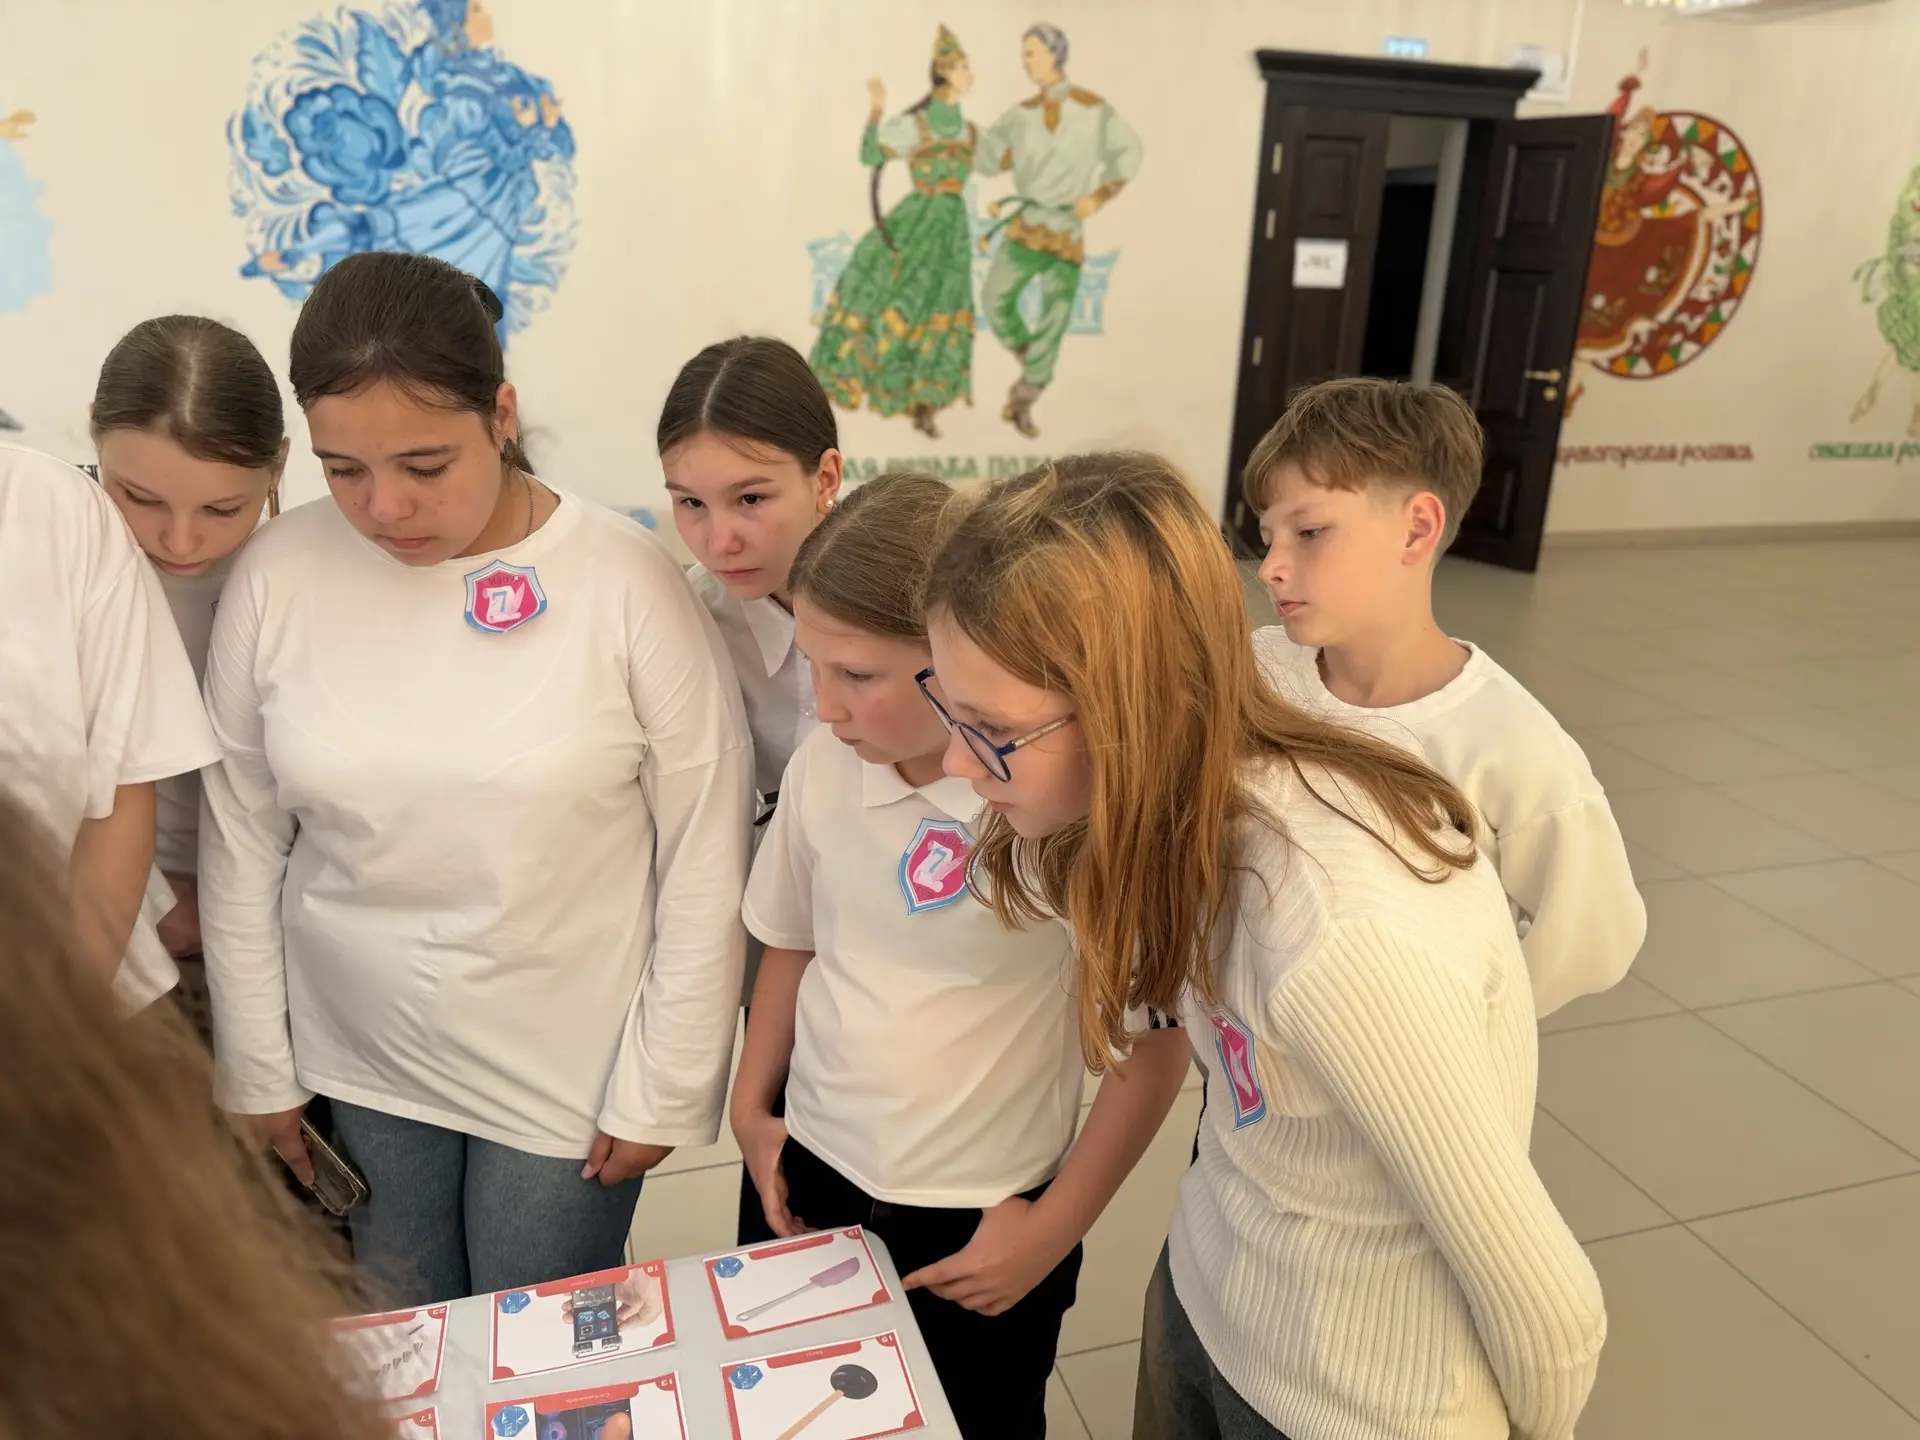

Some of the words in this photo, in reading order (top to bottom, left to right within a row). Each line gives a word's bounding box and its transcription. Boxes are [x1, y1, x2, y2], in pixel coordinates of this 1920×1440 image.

[492, 590, 507, 613] 7
[931, 846, 948, 873] 7
[660, 1379, 673, 1387] 13
[420, 1413, 433, 1423] 17
